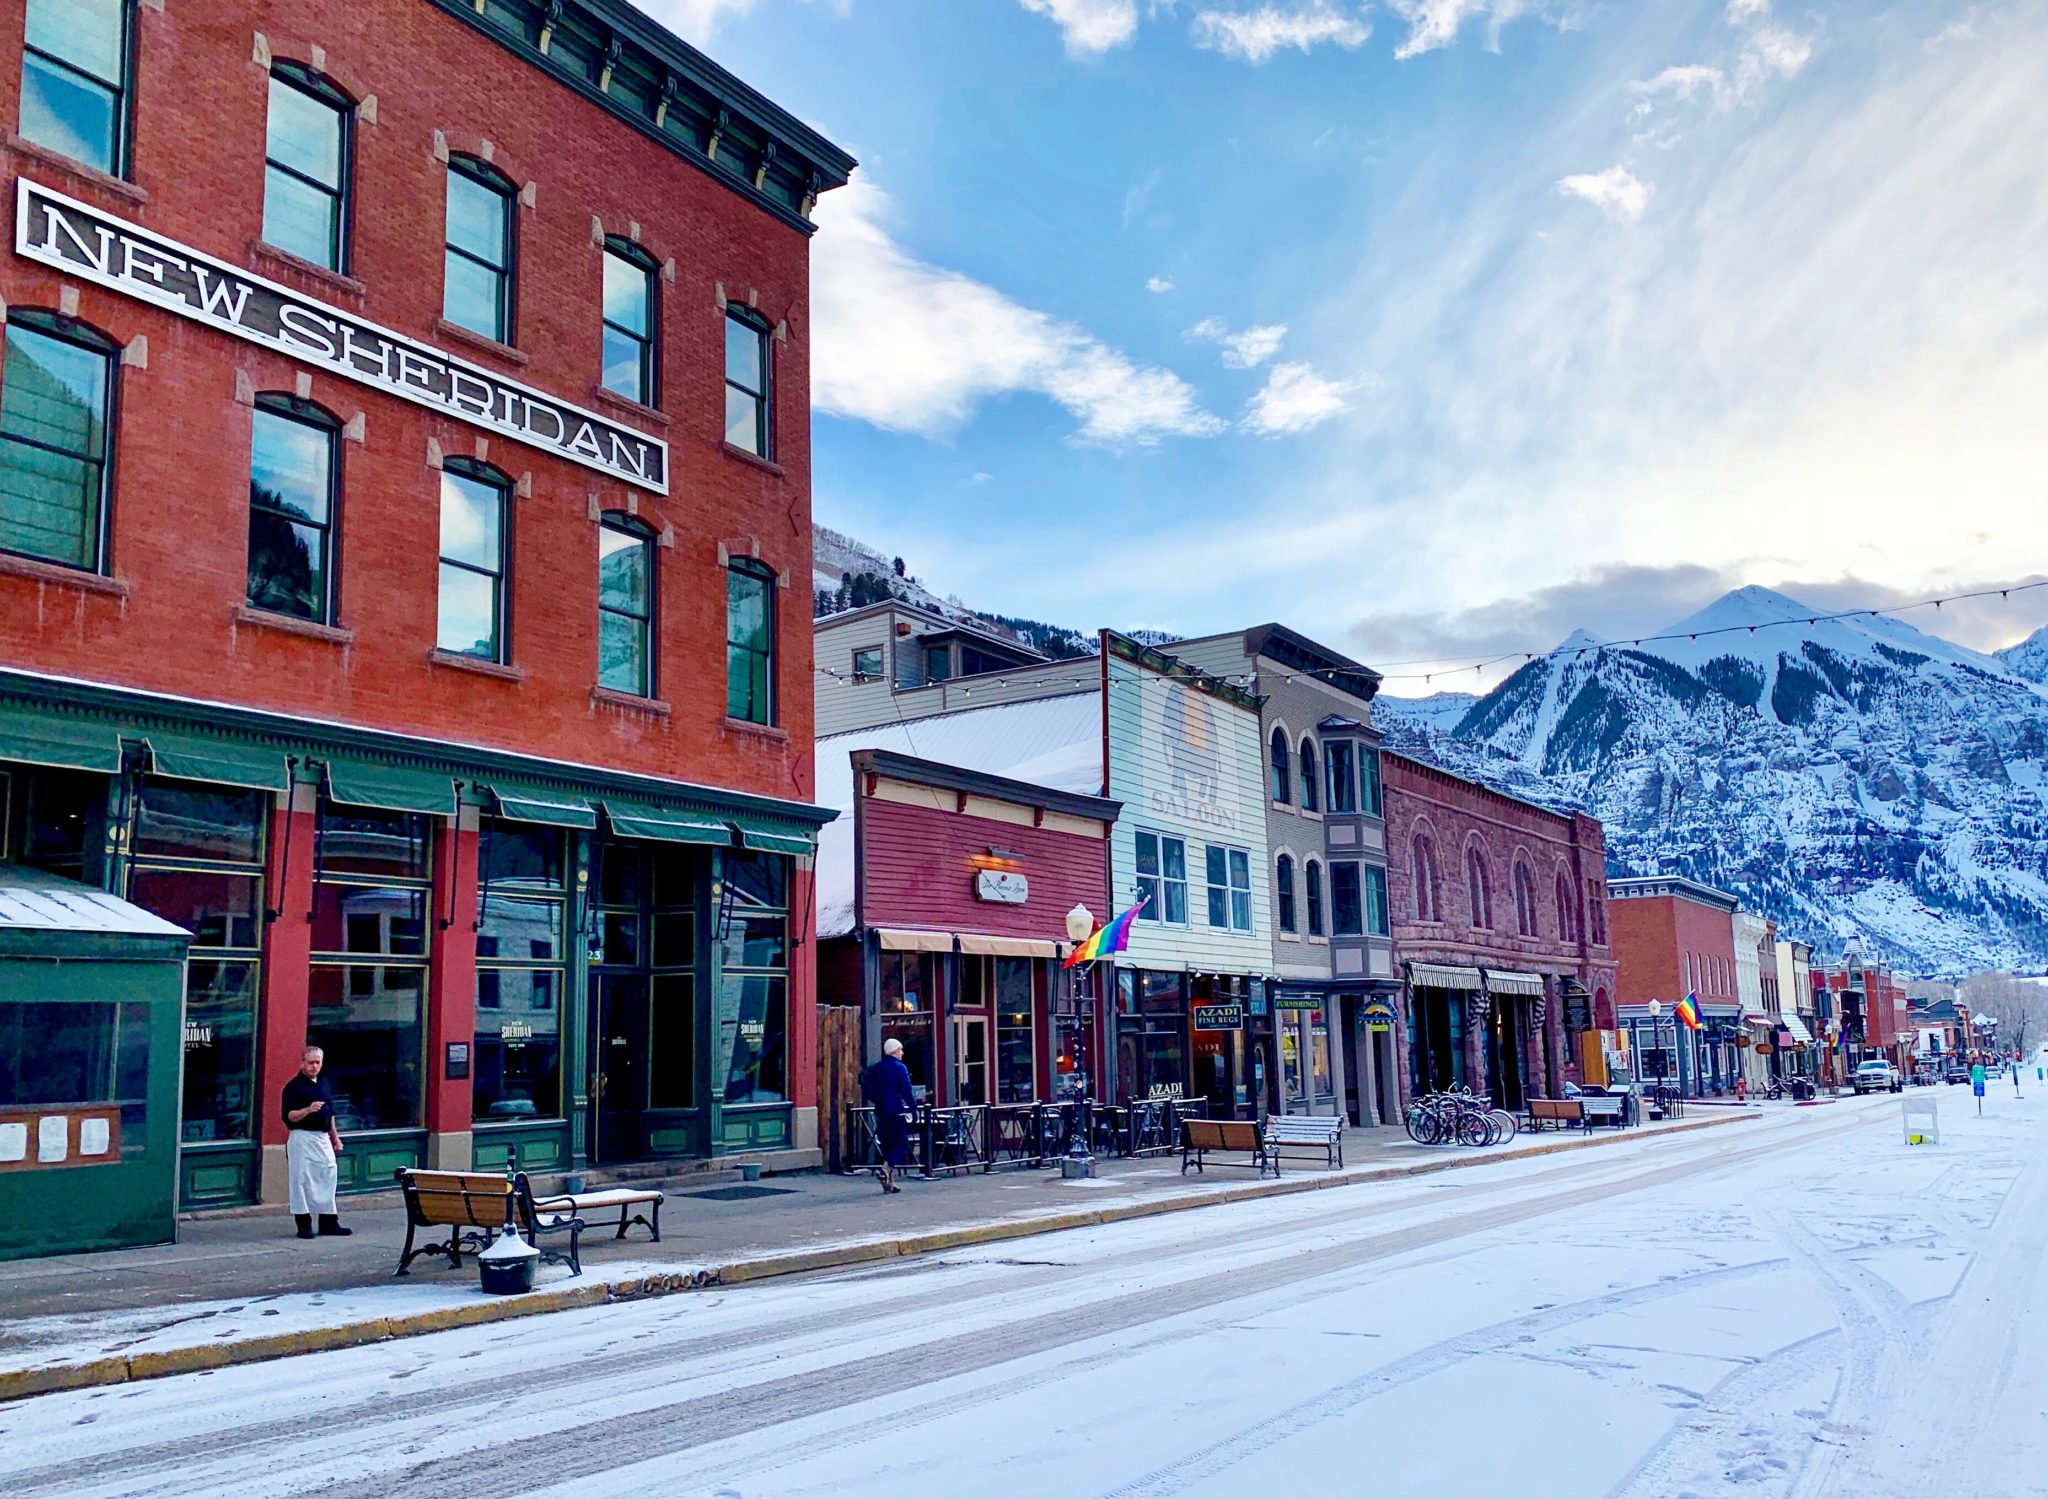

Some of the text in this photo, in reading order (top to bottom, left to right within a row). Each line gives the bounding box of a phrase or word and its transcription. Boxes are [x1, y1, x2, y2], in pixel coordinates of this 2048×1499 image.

[43, 204, 253, 324] NEW
[1152, 791, 1236, 831] SALOON
[1199, 1008, 1238, 1017] AZADI
[1218, 1016, 1239, 1024] RUGS
[501, 1025, 532, 1039] SHERIDAN
[1149, 1082, 1184, 1096] AZADI
